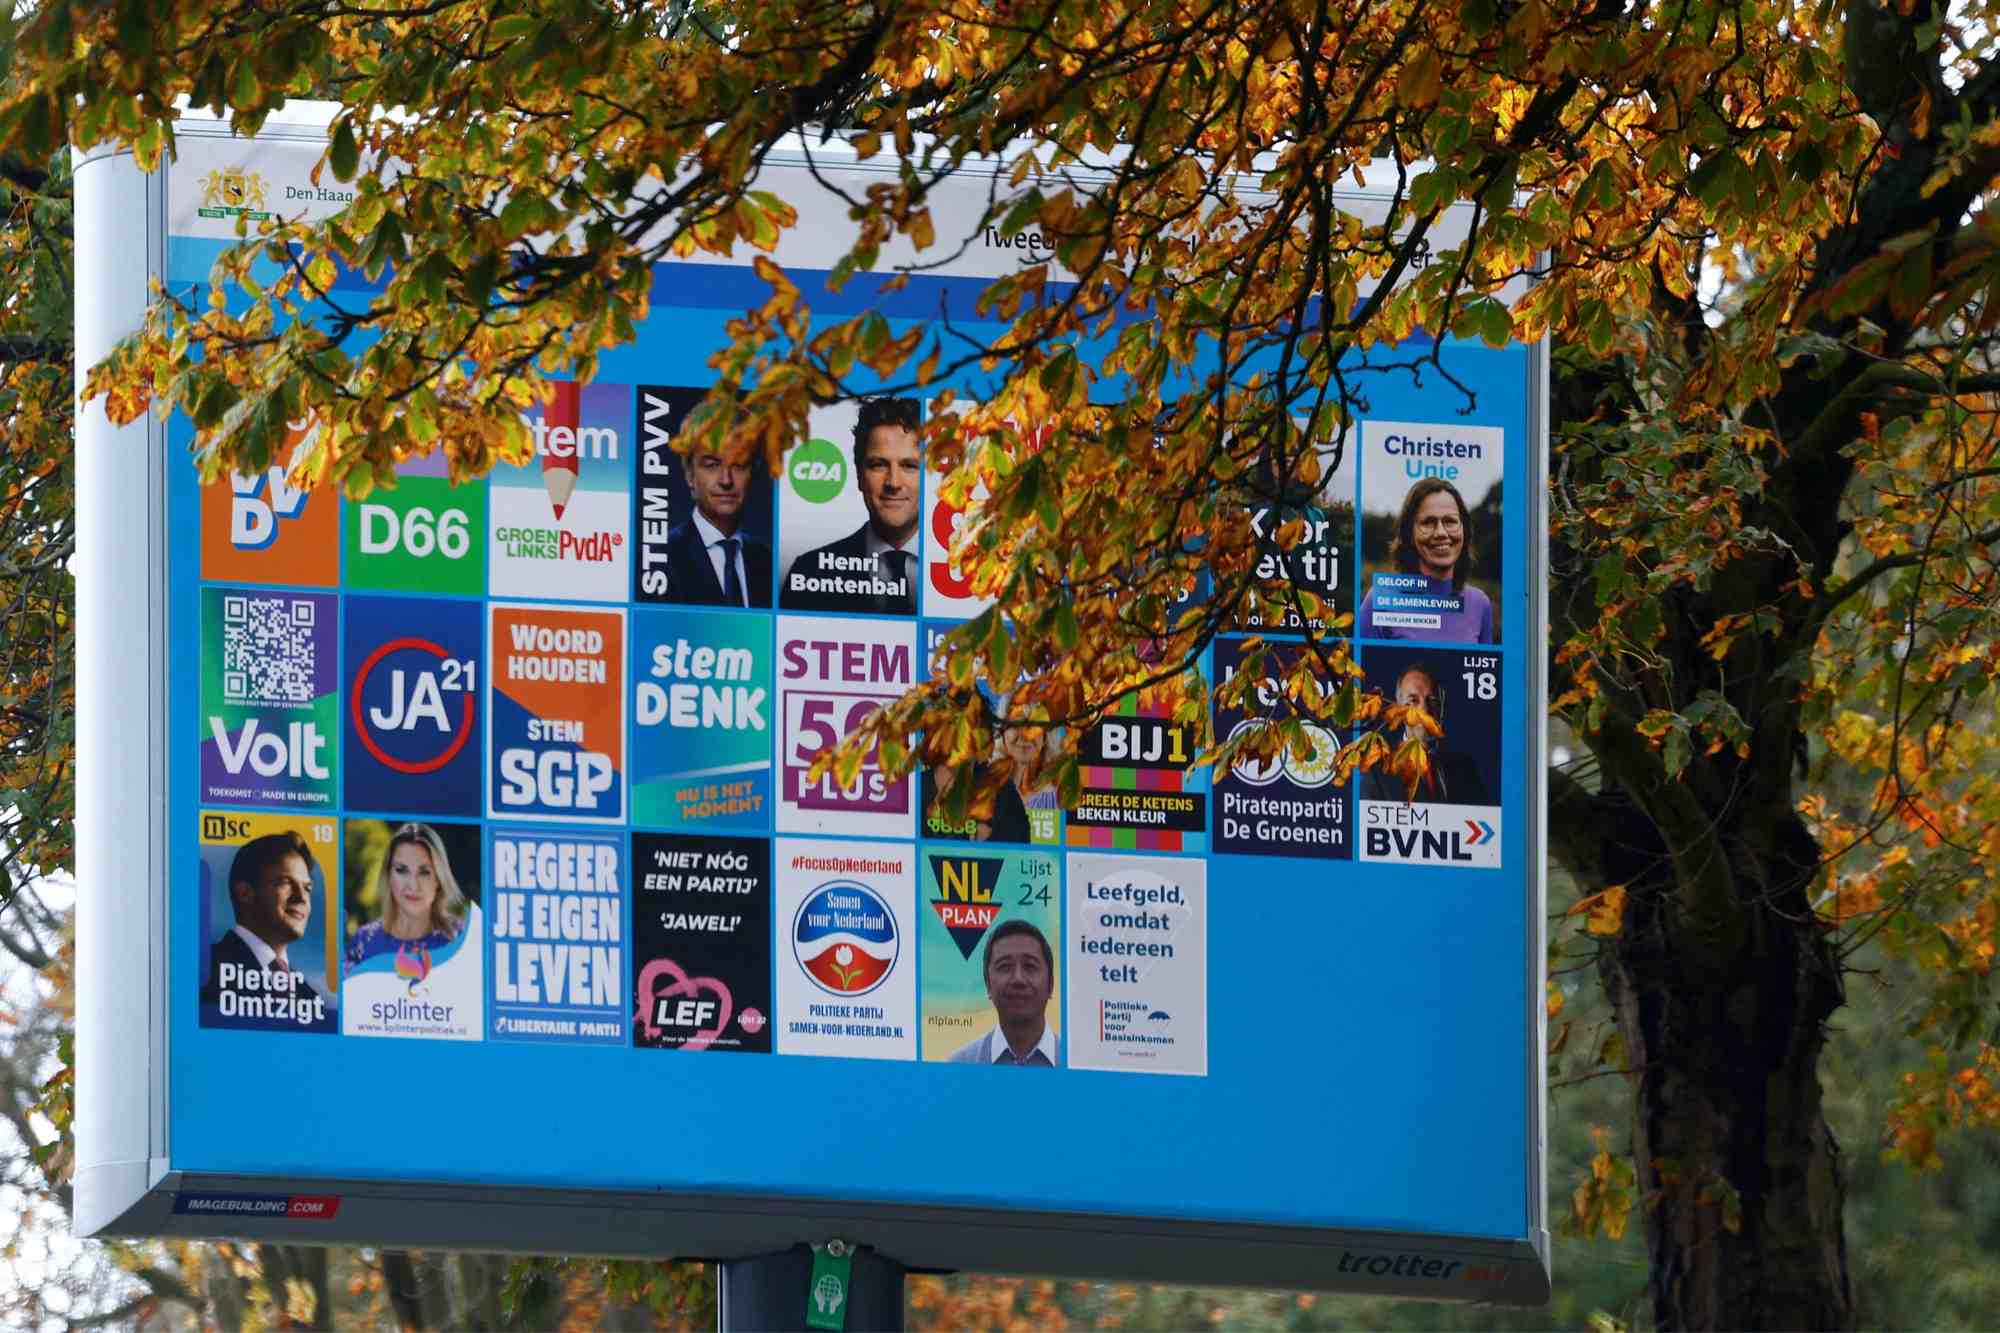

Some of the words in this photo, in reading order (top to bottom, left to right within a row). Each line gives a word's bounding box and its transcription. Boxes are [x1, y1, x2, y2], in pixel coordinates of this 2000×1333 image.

[286, 186, 313, 200] Den
[527, 415, 618, 460] tem
[643, 393, 671, 476] PVV
[1384, 435, 1482, 459] Christen
[793, 461, 841, 482] CDA
[1405, 458, 1459, 481] Unie
[360, 504, 471, 560] D66
[496, 528, 558, 545] GROEN
[642, 488, 669, 595] STEM
[506, 543, 558, 561] LINKS
[559, 530, 613, 562] PvdA
[818, 552, 879, 573] Henri
[1301, 546, 1340, 592] tij
[790, 573, 907, 597] Bontenbal
[1376, 576, 1416, 588] GELOOF
[1417, 579, 1428, 589] IN
[1376, 596, 1391, 606] DE
[1392, 597, 1460, 609] SAMENLEVING
[511, 624, 603, 654] WOORD
[508, 656, 606, 683] HOUDEN
[650, 639, 753, 681] stem
[783, 640, 910, 684] STEM
[1463, 657, 1498, 669] LIJST
[369, 659, 475, 732] JA21
[1462, 672, 1497, 701] 18
[636, 682, 766, 731] DENK
[527, 719, 584, 742] STEM
[208, 716, 330, 780] Volt
[1102, 723, 1188, 763] BIJ1
[500, 749, 613, 809] SGP
[798, 770, 888, 802] PLUS
[262, 791, 286, 801] MADE
[287, 793, 297, 801] IN
[297, 794, 329, 803] EUROPE
[1122, 796, 1141, 808] DE
[1143, 797, 1194, 812] KETENS
[1223, 793, 1343, 823] Piratenpartij
[1076, 808, 1121, 822] BEKEN
[1123, 811, 1167, 824] KLEUR
[1367, 805, 1429, 826] STEM
[1032, 820, 1055, 839] 15
[1223, 819, 1251, 839] De
[1256, 821, 1343, 844] Groenen
[1366, 828, 1473, 861] BVNL
[494, 840, 620, 893] REGEER
[705, 851, 749, 871] NÓG
[792, 855, 903, 875] #FocusOpNederland
[1019, 859, 1053, 879] Lijst
[644, 873, 682, 891] EEN
[942, 861, 991, 904] NL
[826, 891, 861, 910] Samen
[1017, 884, 1053, 908] 24
[1087, 882, 1186, 906] Leefgeld,
[494, 893, 526, 938] JE
[532, 894, 620, 942] EIGEN
[807, 913, 831, 928] voor
[833, 910, 885, 931] Nederland
[942, 907, 992, 925] PLAN
[1100, 911, 1171, 931] omdat
[1081, 936, 1174, 958] iedereen
[219, 963, 305, 992] Pieter
[495, 942, 621, 1007] LEVEN
[1099, 964, 1139, 983] telt
[219, 990, 325, 1025] Omtzigt
[372, 998, 454, 1025] splinter
[656, 999, 715, 1027] LEF
[809, 1004, 851, 1018] POLITIEKE
[853, 1006, 884, 1020] PARTIJ
[1104, 1001, 1149, 1012] Politieke
[1104, 1011, 1132, 1023] Partij
[507, 1018, 577, 1035] LIBERTAIRE
[580, 1022, 621, 1037] PARTIJ
[789, 1021, 905, 1039] SAMEN-VOOR-NEDERLAND.NL
[928, 1015, 973, 1028] nlplan.nl
[1104, 1023, 1127, 1032] voor
[1104, 1033, 1175, 1045] Basisinkomen
[1337, 1252, 1464, 1280] trotter
